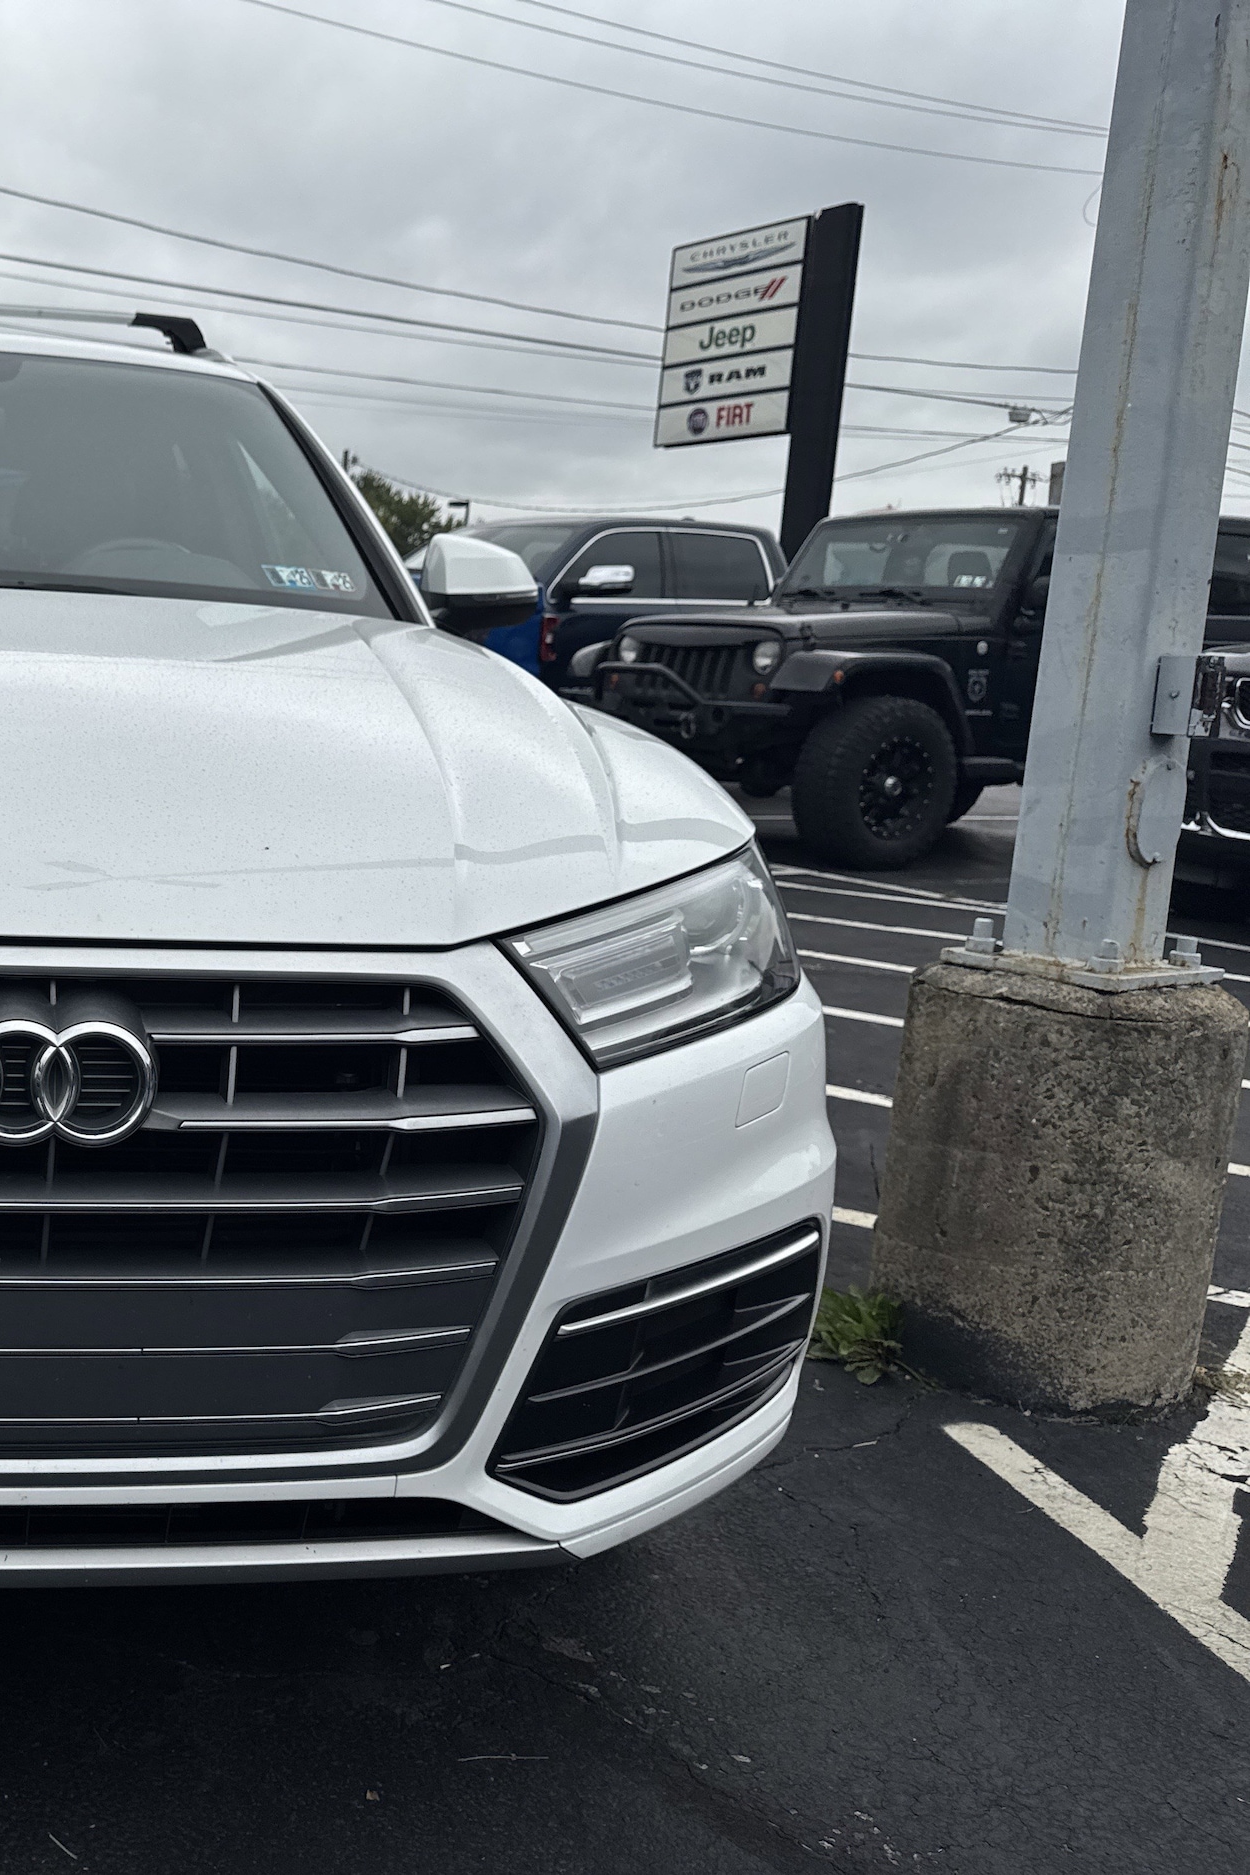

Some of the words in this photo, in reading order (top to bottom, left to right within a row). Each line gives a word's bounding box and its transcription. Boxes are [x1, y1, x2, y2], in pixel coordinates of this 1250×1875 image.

[690, 230, 789, 262] CHRYSLER
[679, 284, 767, 312] DODGE
[700, 324, 756, 350] Jeep
[707, 365, 767, 384] RAM
[715, 403, 754, 428] FIAT
